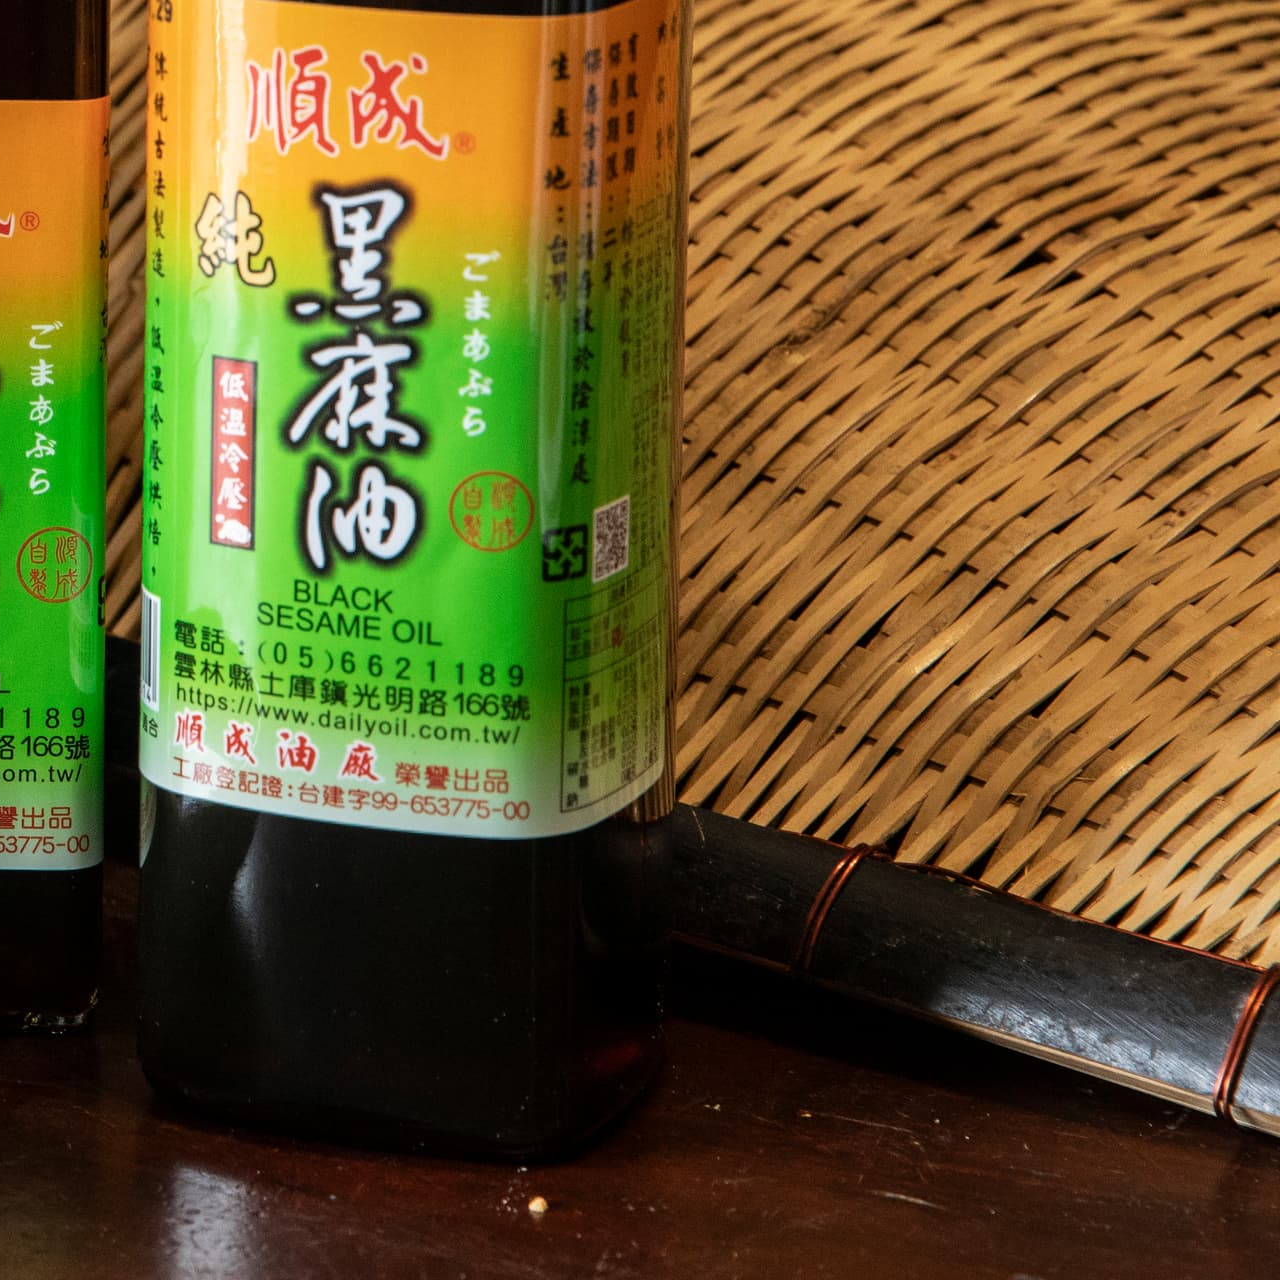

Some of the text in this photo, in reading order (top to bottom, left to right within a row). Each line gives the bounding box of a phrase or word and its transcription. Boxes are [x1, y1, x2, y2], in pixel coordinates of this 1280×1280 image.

[247, 48, 448, 158] 順成
[196, 190, 276, 287] 純
[459, 251, 501, 437] ごまあぶら
[25, 320, 63, 496] ごまあぶら
[257, 602, 443, 646] SESAME OIL
[293, 580, 393, 614] BLACK
[176, 712, 509, 795] 順成油廠 榮譽出品
[177, 682, 520, 745] https://www.dailyoil.com.tw/
